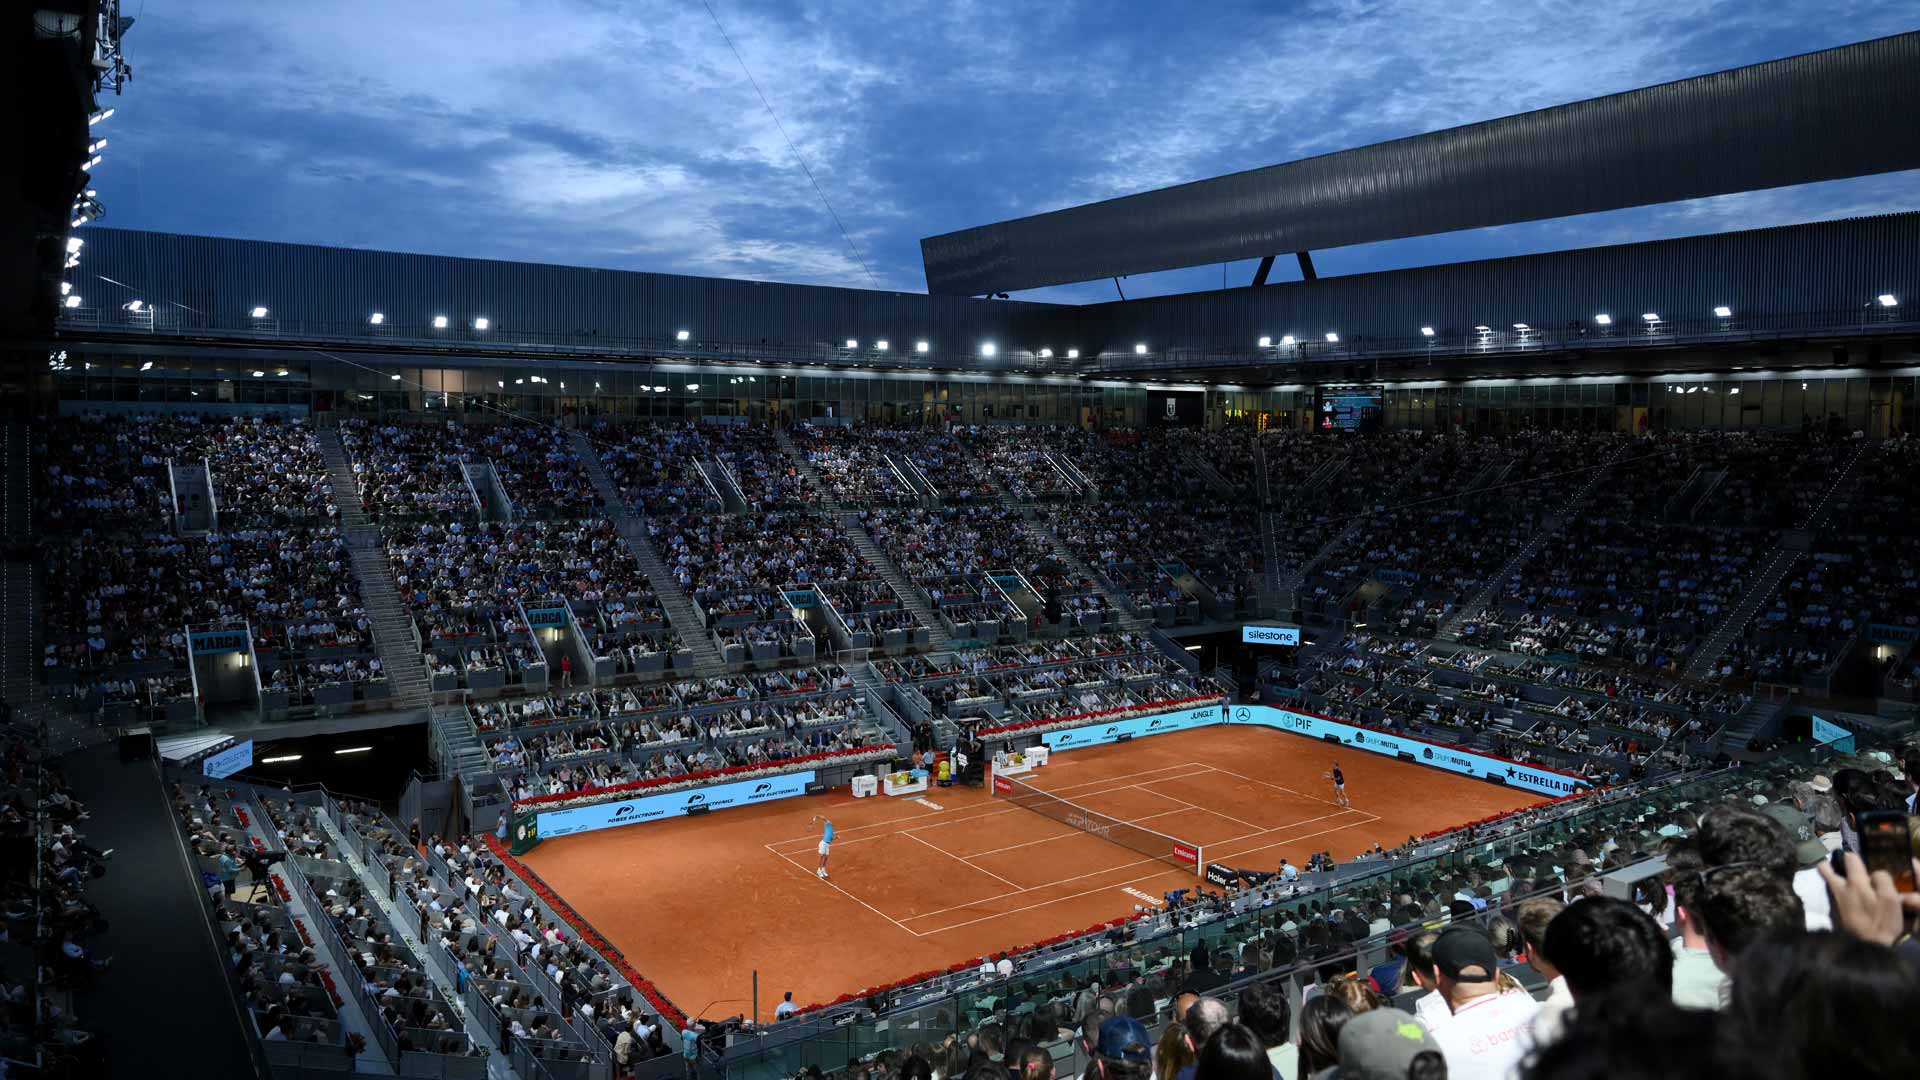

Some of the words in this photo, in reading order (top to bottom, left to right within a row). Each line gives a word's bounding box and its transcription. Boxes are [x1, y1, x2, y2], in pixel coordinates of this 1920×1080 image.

[193, 635, 241, 650] MARCA
[1248, 631, 1293, 641] silestone
[1190, 709, 1214, 720] JUNGLE
[1295, 718, 1312, 730] PIF
[1518, 772, 1561, 790] ESTRELLA
[1562, 783, 1575, 793] DA
[608, 816, 627, 824] POWER
[628, 810, 665, 820] ELECTRONICS
[1174, 847, 1196, 860] Emirates
[1207, 871, 1226, 885] Haier
[1121, 887, 1164, 905] MADRID
